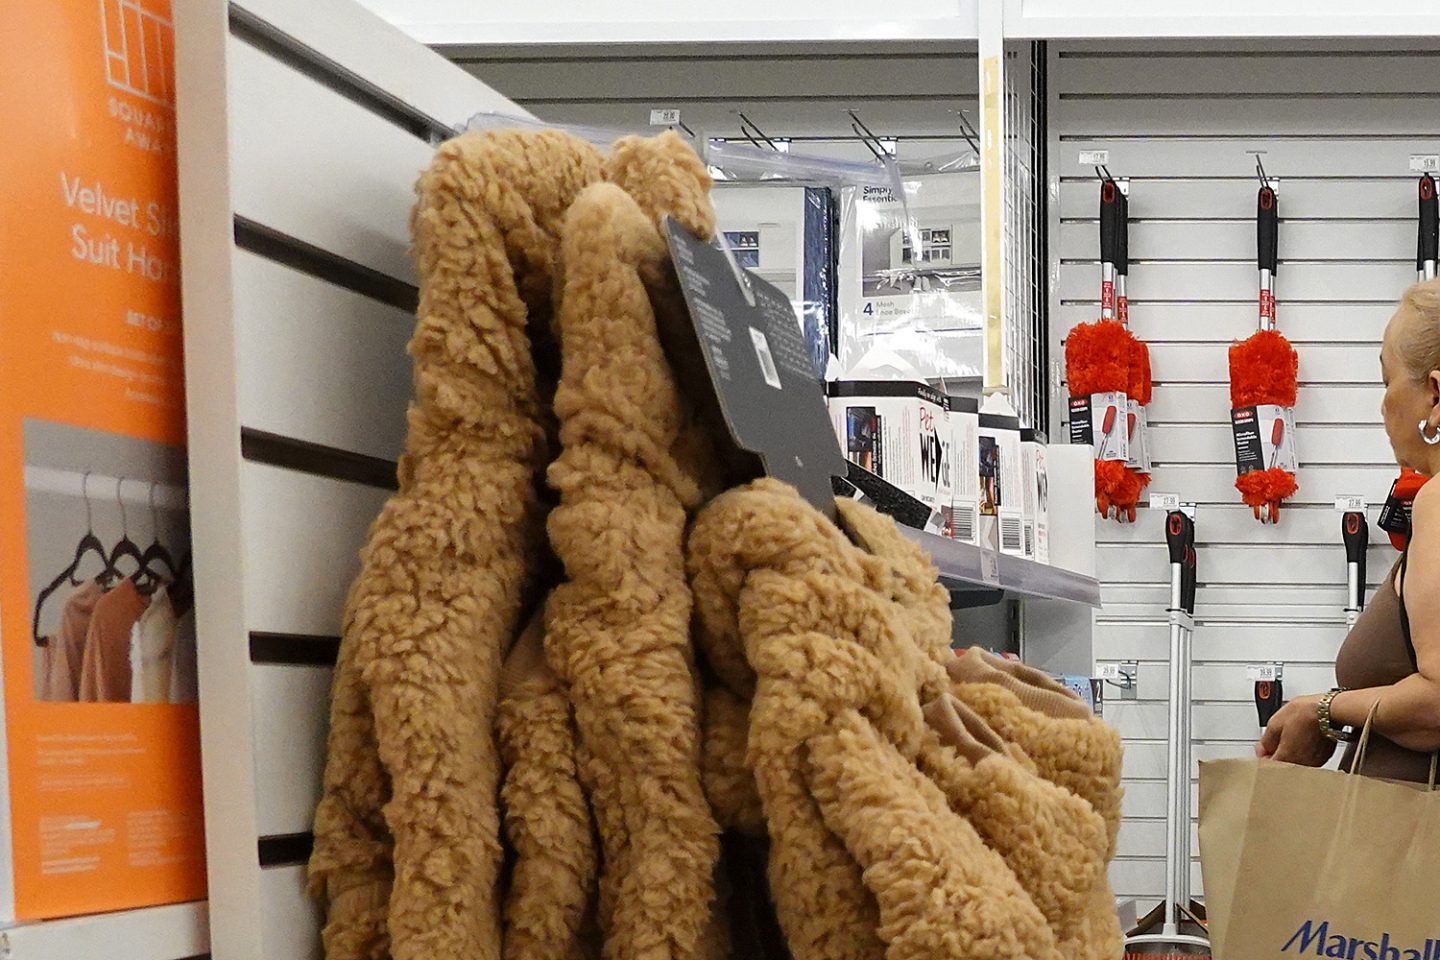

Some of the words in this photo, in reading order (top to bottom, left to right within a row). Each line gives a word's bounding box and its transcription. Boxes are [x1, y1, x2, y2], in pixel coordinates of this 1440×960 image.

[60, 170, 141, 231] Velvet
[70, 222, 121, 271] Suit
[863, 302, 875, 316] 4
